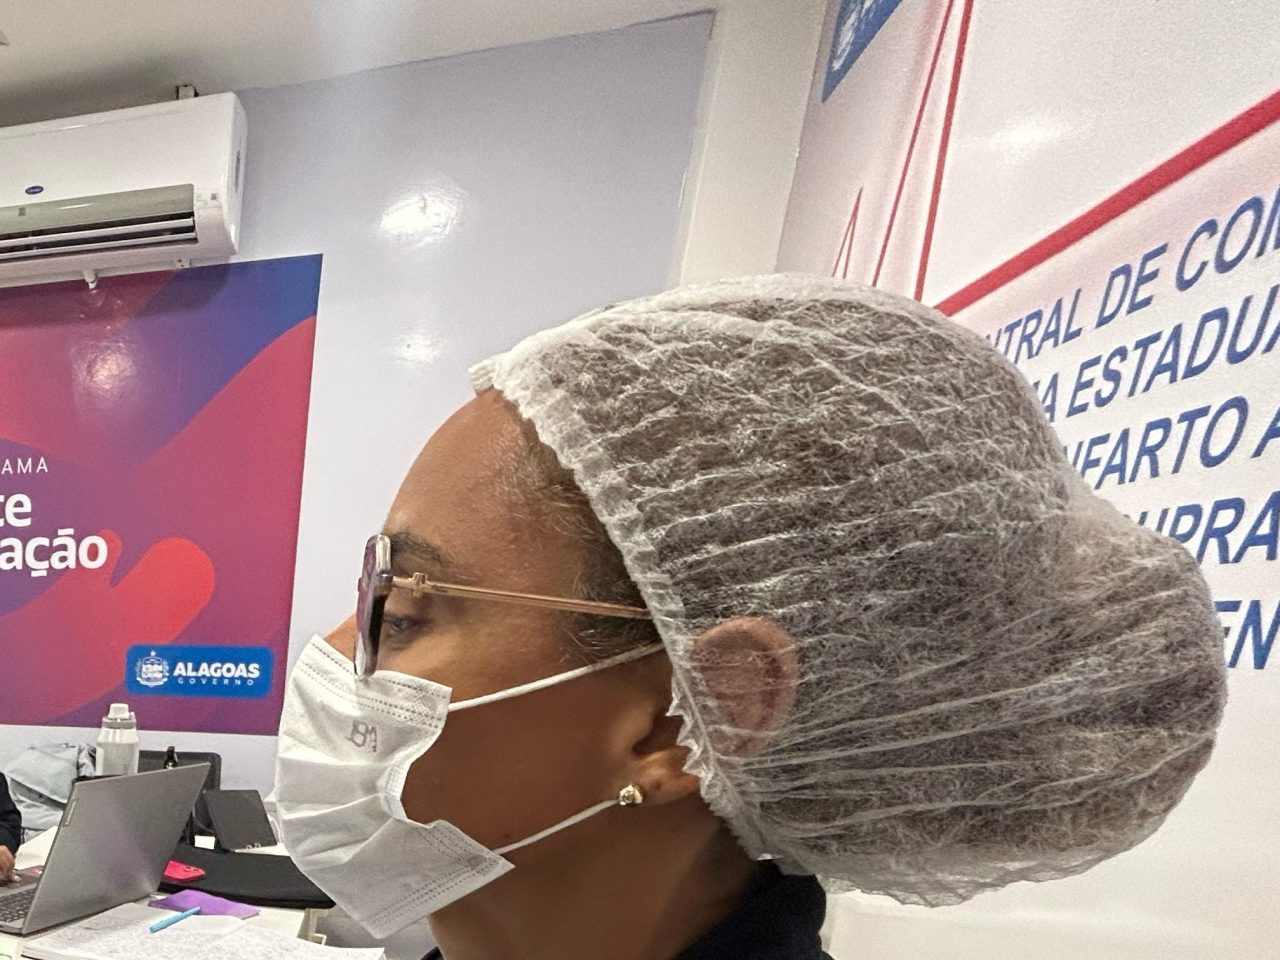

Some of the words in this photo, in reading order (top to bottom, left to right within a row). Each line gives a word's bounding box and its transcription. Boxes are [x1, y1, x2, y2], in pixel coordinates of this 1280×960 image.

[1095, 243, 1168, 329] DE
[173, 661, 261, 679] ALAGOAS
[178, 678, 254, 687] GOVERNO
